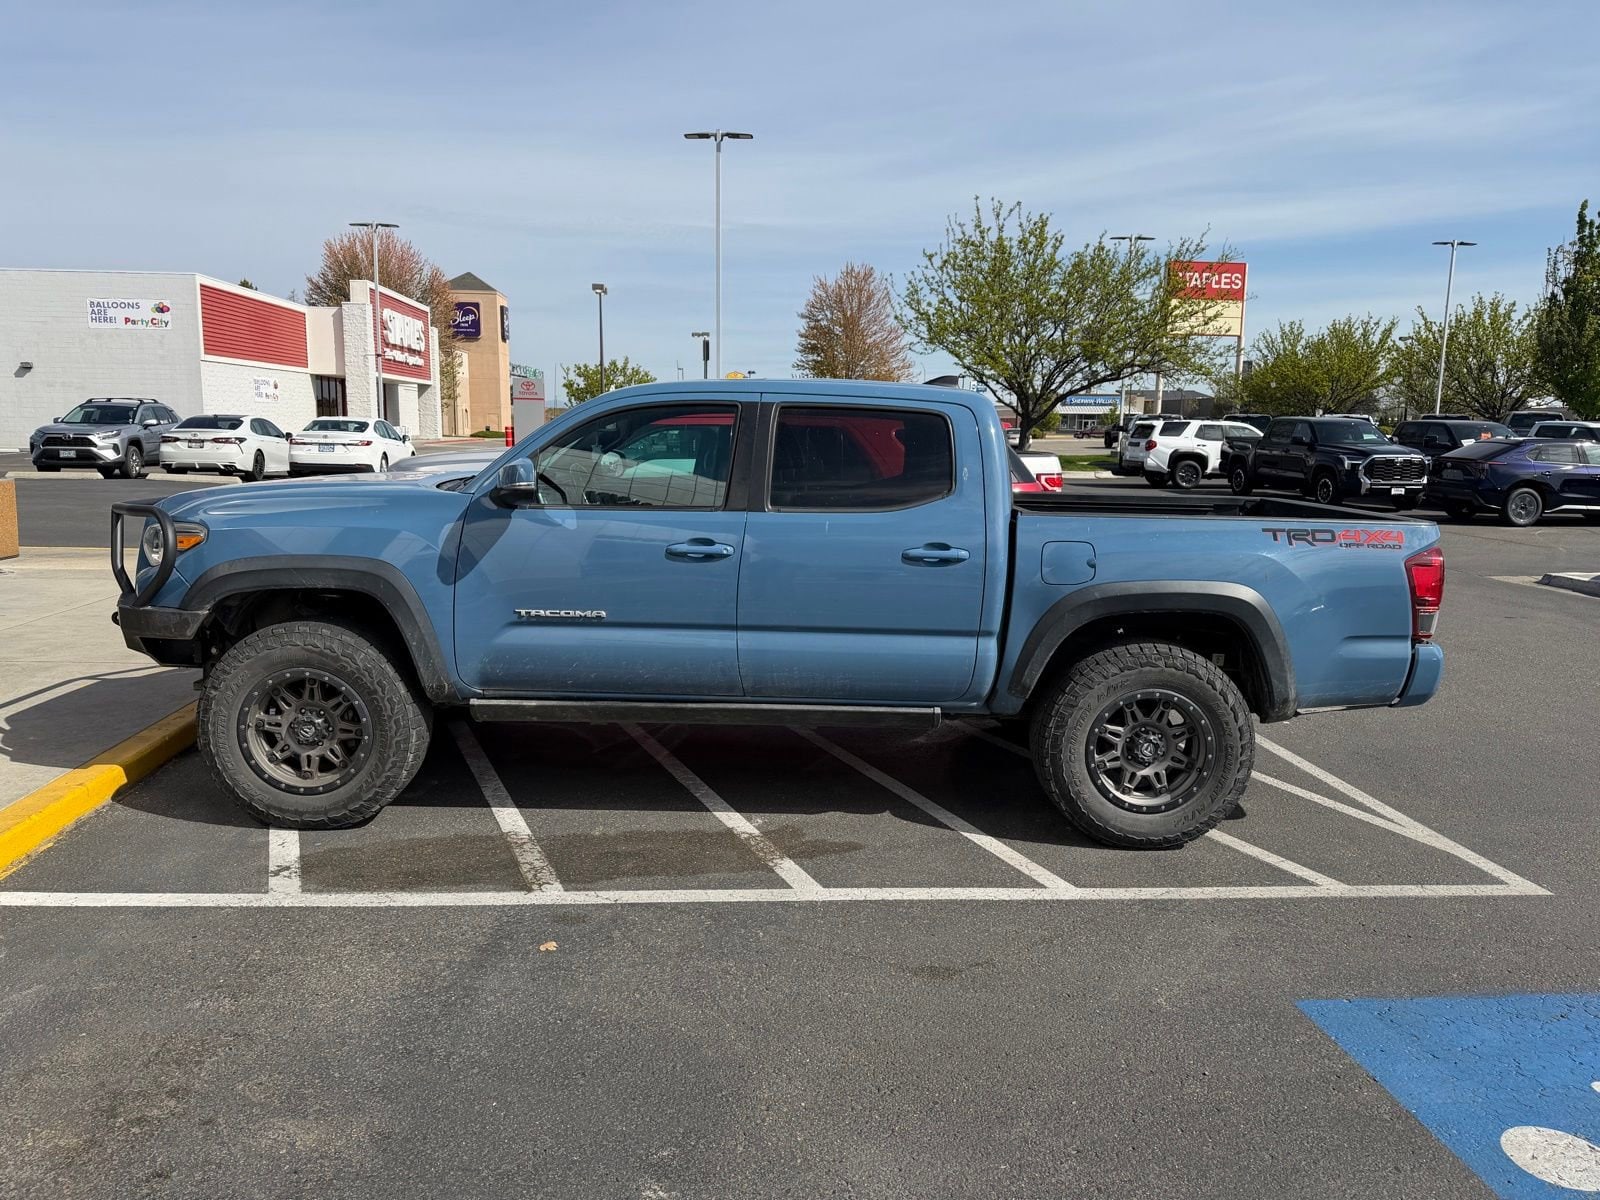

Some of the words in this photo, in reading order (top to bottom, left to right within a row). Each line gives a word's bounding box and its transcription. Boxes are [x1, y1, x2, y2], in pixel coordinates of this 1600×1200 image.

[1177, 272, 1242, 289] TAPLES
[89, 301, 140, 310] BALLOONS
[90, 316, 117, 324] HERE!
[124, 317, 149, 328] Party
[150, 318, 169, 327] City
[383, 308, 425, 352] STAPLES
[1262, 527, 1337, 547] TRD
[1367, 542, 1403, 550] ROAD
[514, 608, 607, 618] TACOMA
